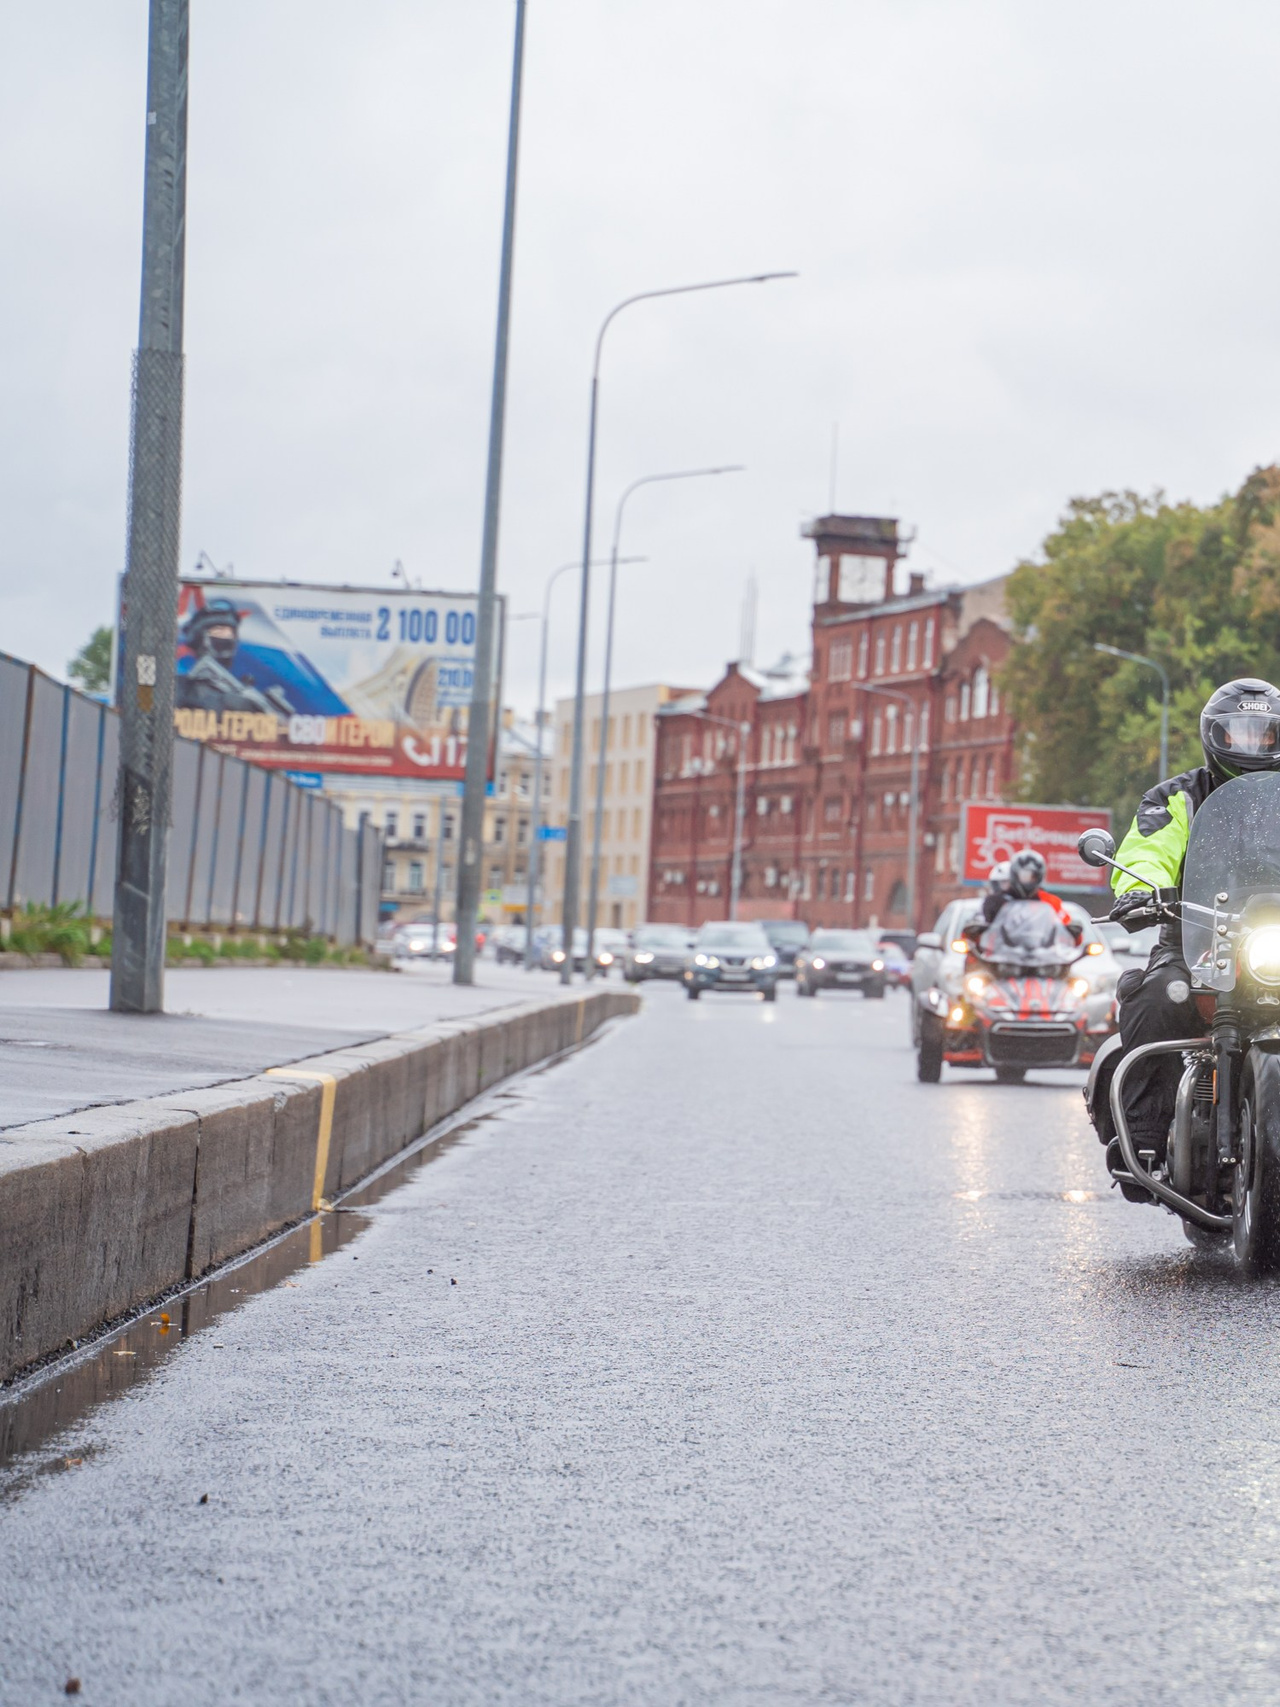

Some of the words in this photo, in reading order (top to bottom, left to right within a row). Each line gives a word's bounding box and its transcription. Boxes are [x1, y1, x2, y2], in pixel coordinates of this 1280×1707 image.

[377, 607, 391, 641] 2
[398, 609, 437, 643] 100
[445, 611, 476, 645] 00
[1241, 702, 1268, 712] SHOEI
[971, 836, 1015, 869] 30
